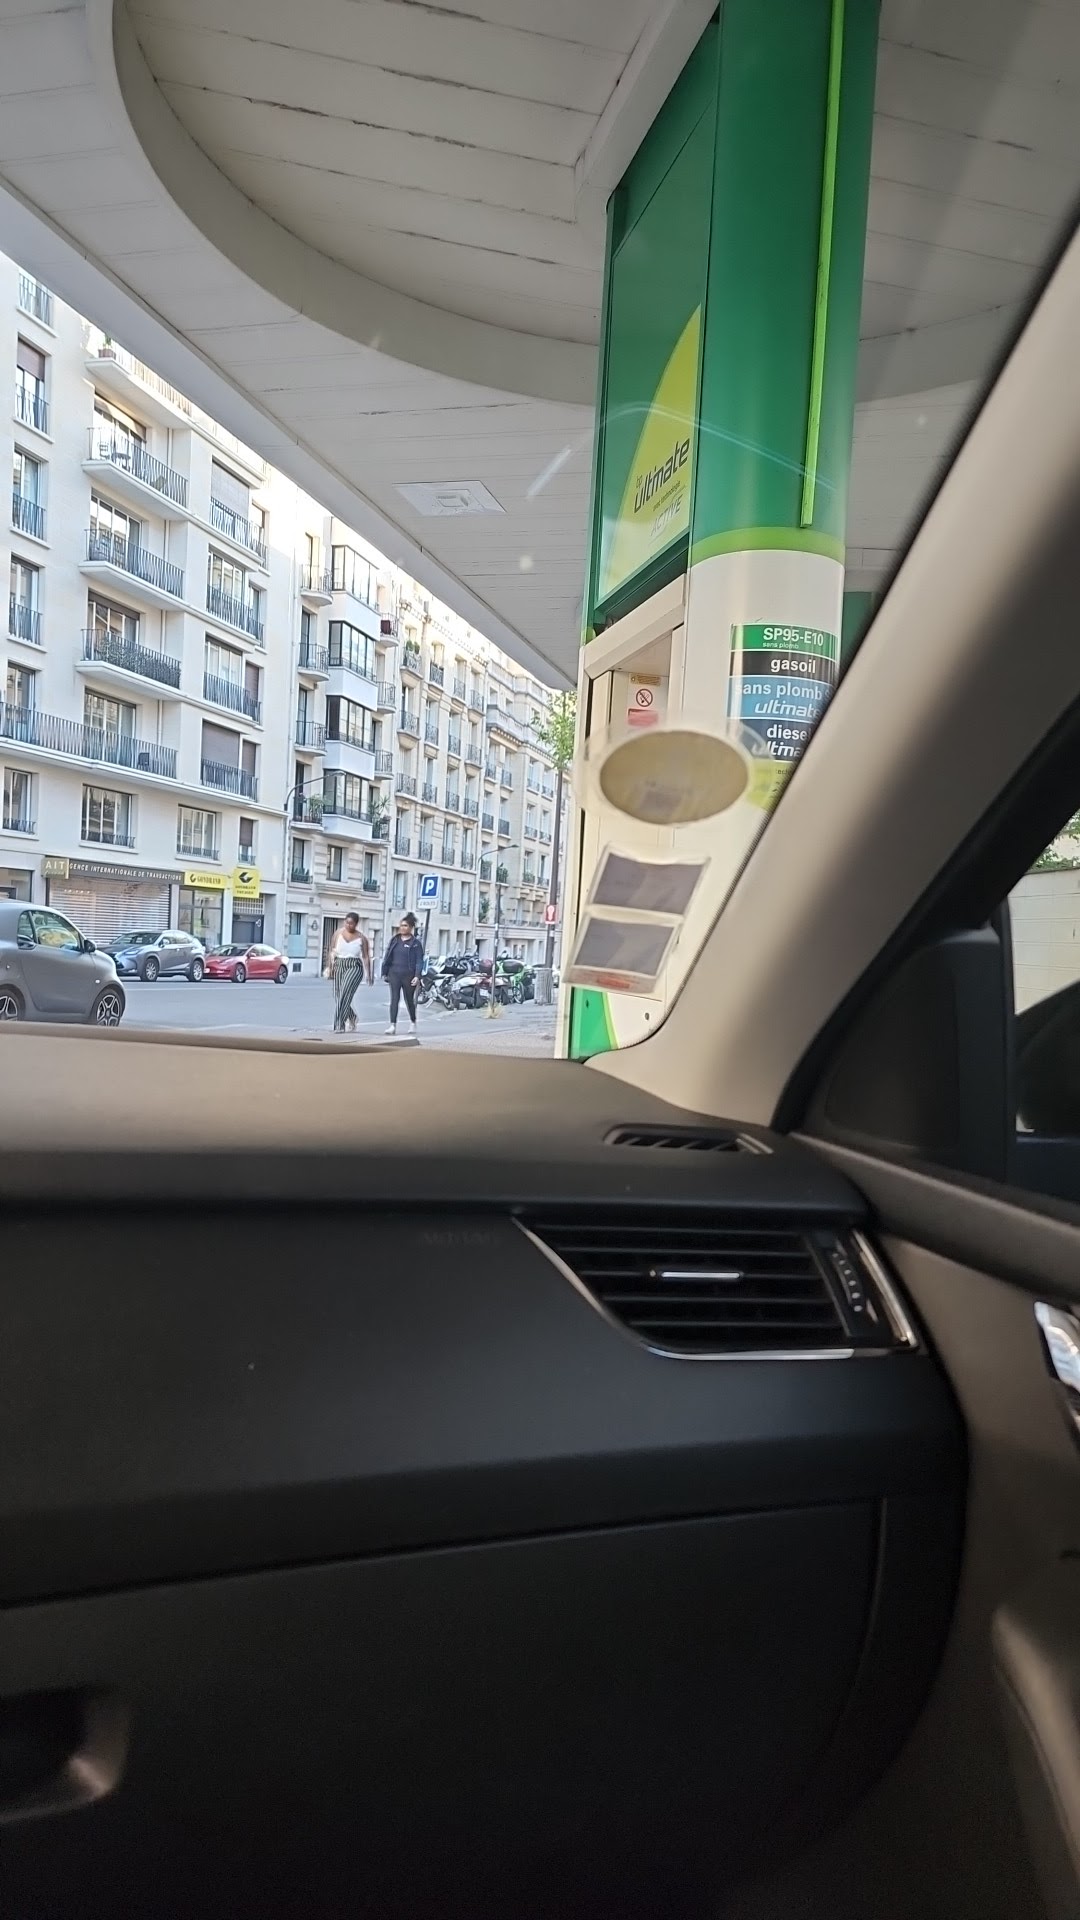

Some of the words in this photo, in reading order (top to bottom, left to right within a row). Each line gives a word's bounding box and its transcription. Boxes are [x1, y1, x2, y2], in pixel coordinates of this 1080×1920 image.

[634, 438, 690, 513] ultimate
[651, 493, 684, 537] ACTIVE
[762, 627, 824, 647] SP95-E10
[778, 642, 800, 650] plomb
[770, 659, 816, 673] gasoil
[776, 681, 822, 700] plomb
[69, 863, 89, 872] GENCE
[90, 865, 137, 877] INTERNATIONALE
[146, 871, 182, 881] TRANSACTIONS
[425, 879, 434, 894] P
